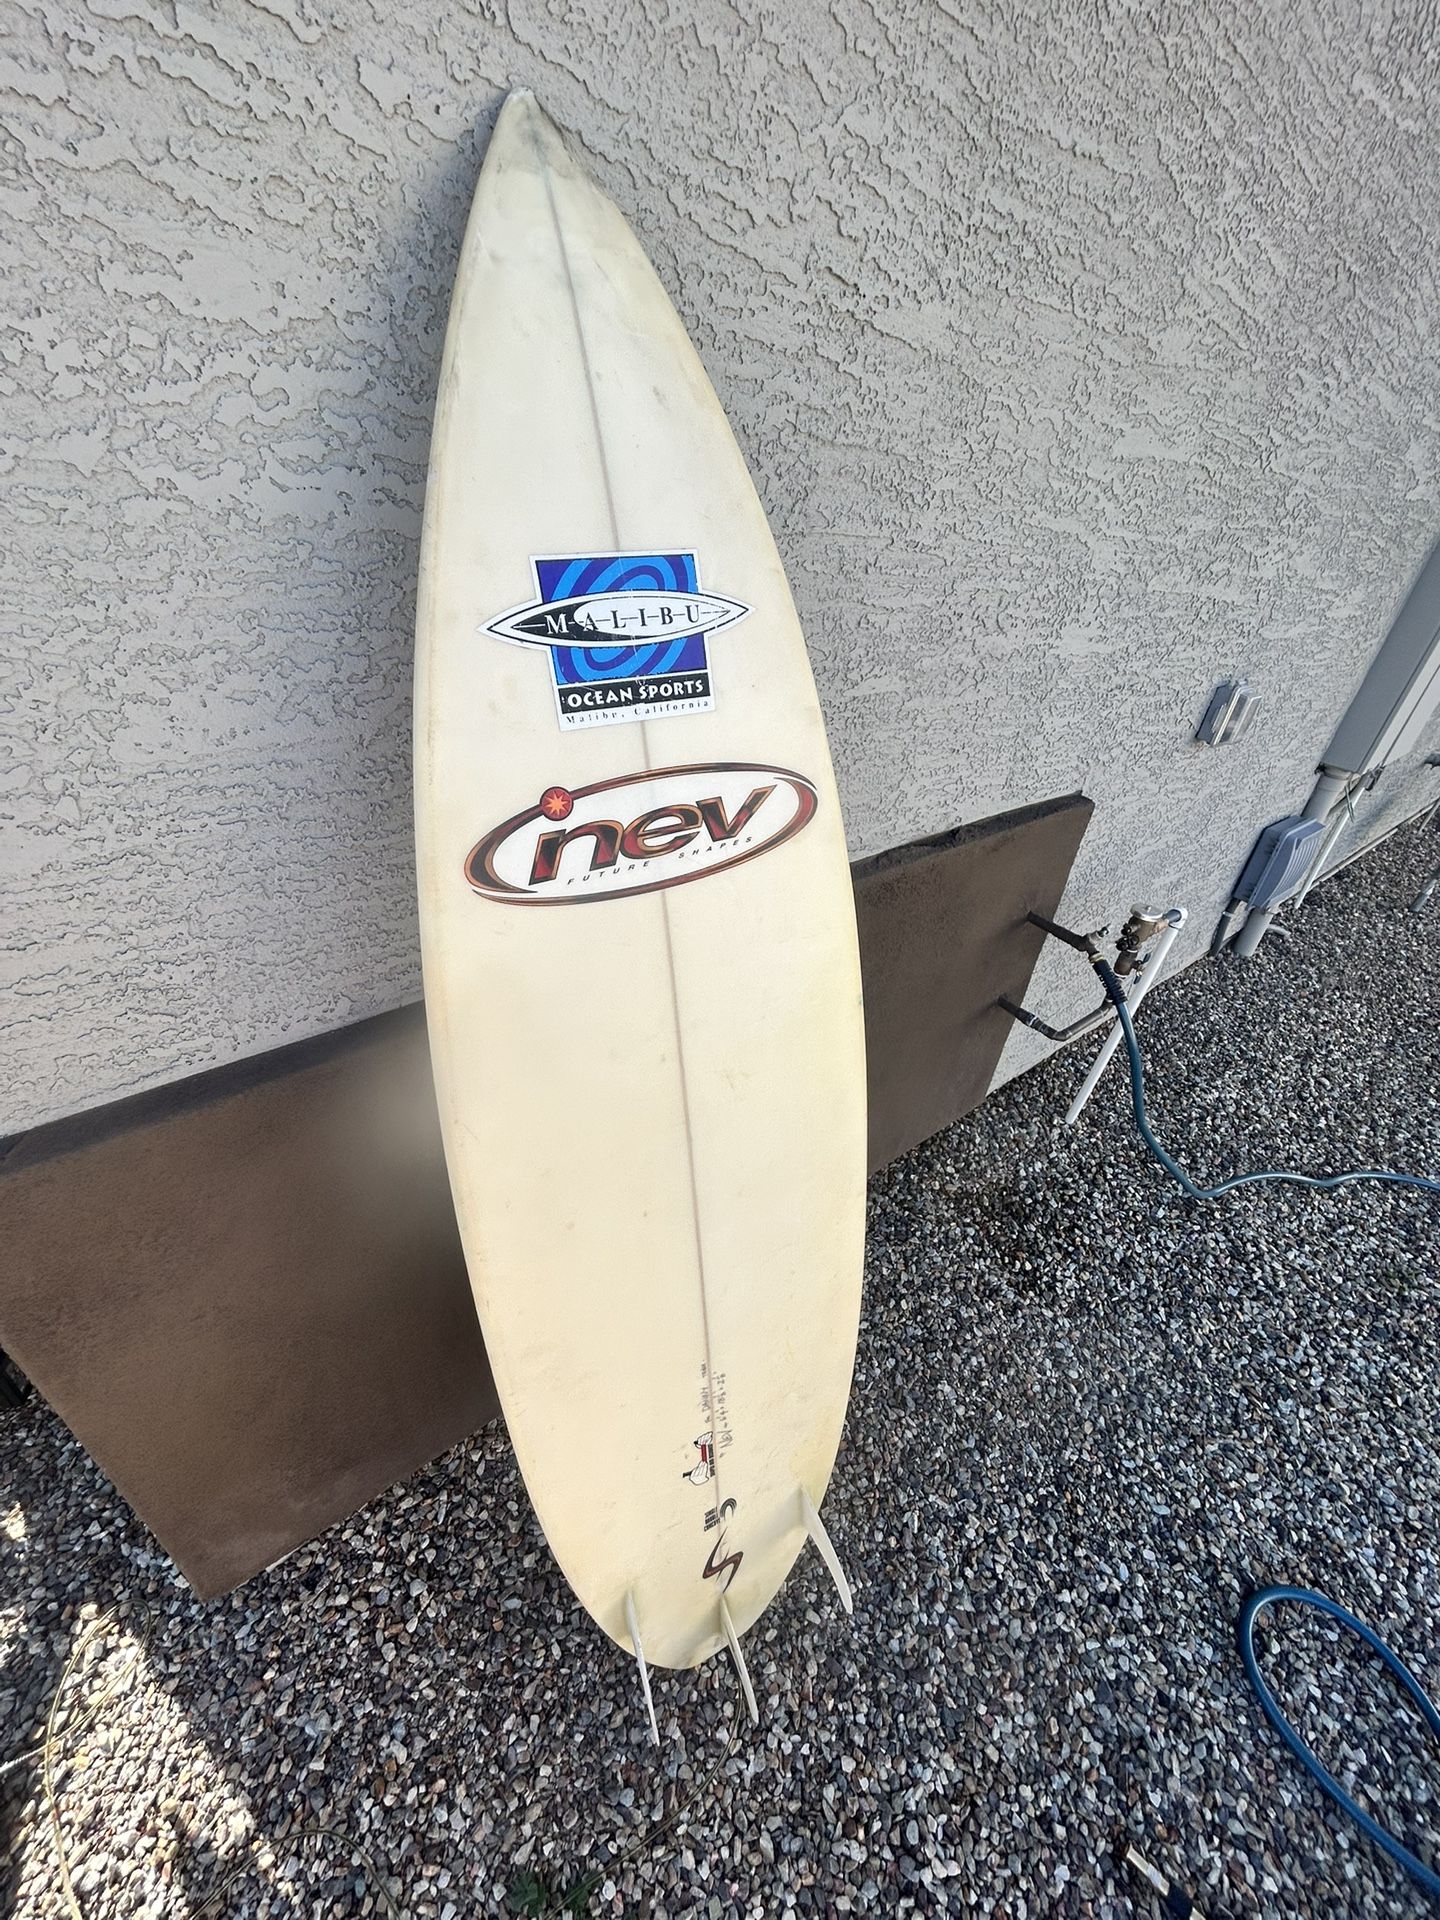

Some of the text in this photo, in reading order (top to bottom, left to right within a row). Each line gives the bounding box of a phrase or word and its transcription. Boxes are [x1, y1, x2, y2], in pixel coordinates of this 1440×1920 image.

[544, 604, 700, 635] MALIBU
[567, 679, 705, 708] OCEAN SPORTS
[634, 700, 710, 716] California
[567, 835, 753, 885] FUTURE SHAPES
